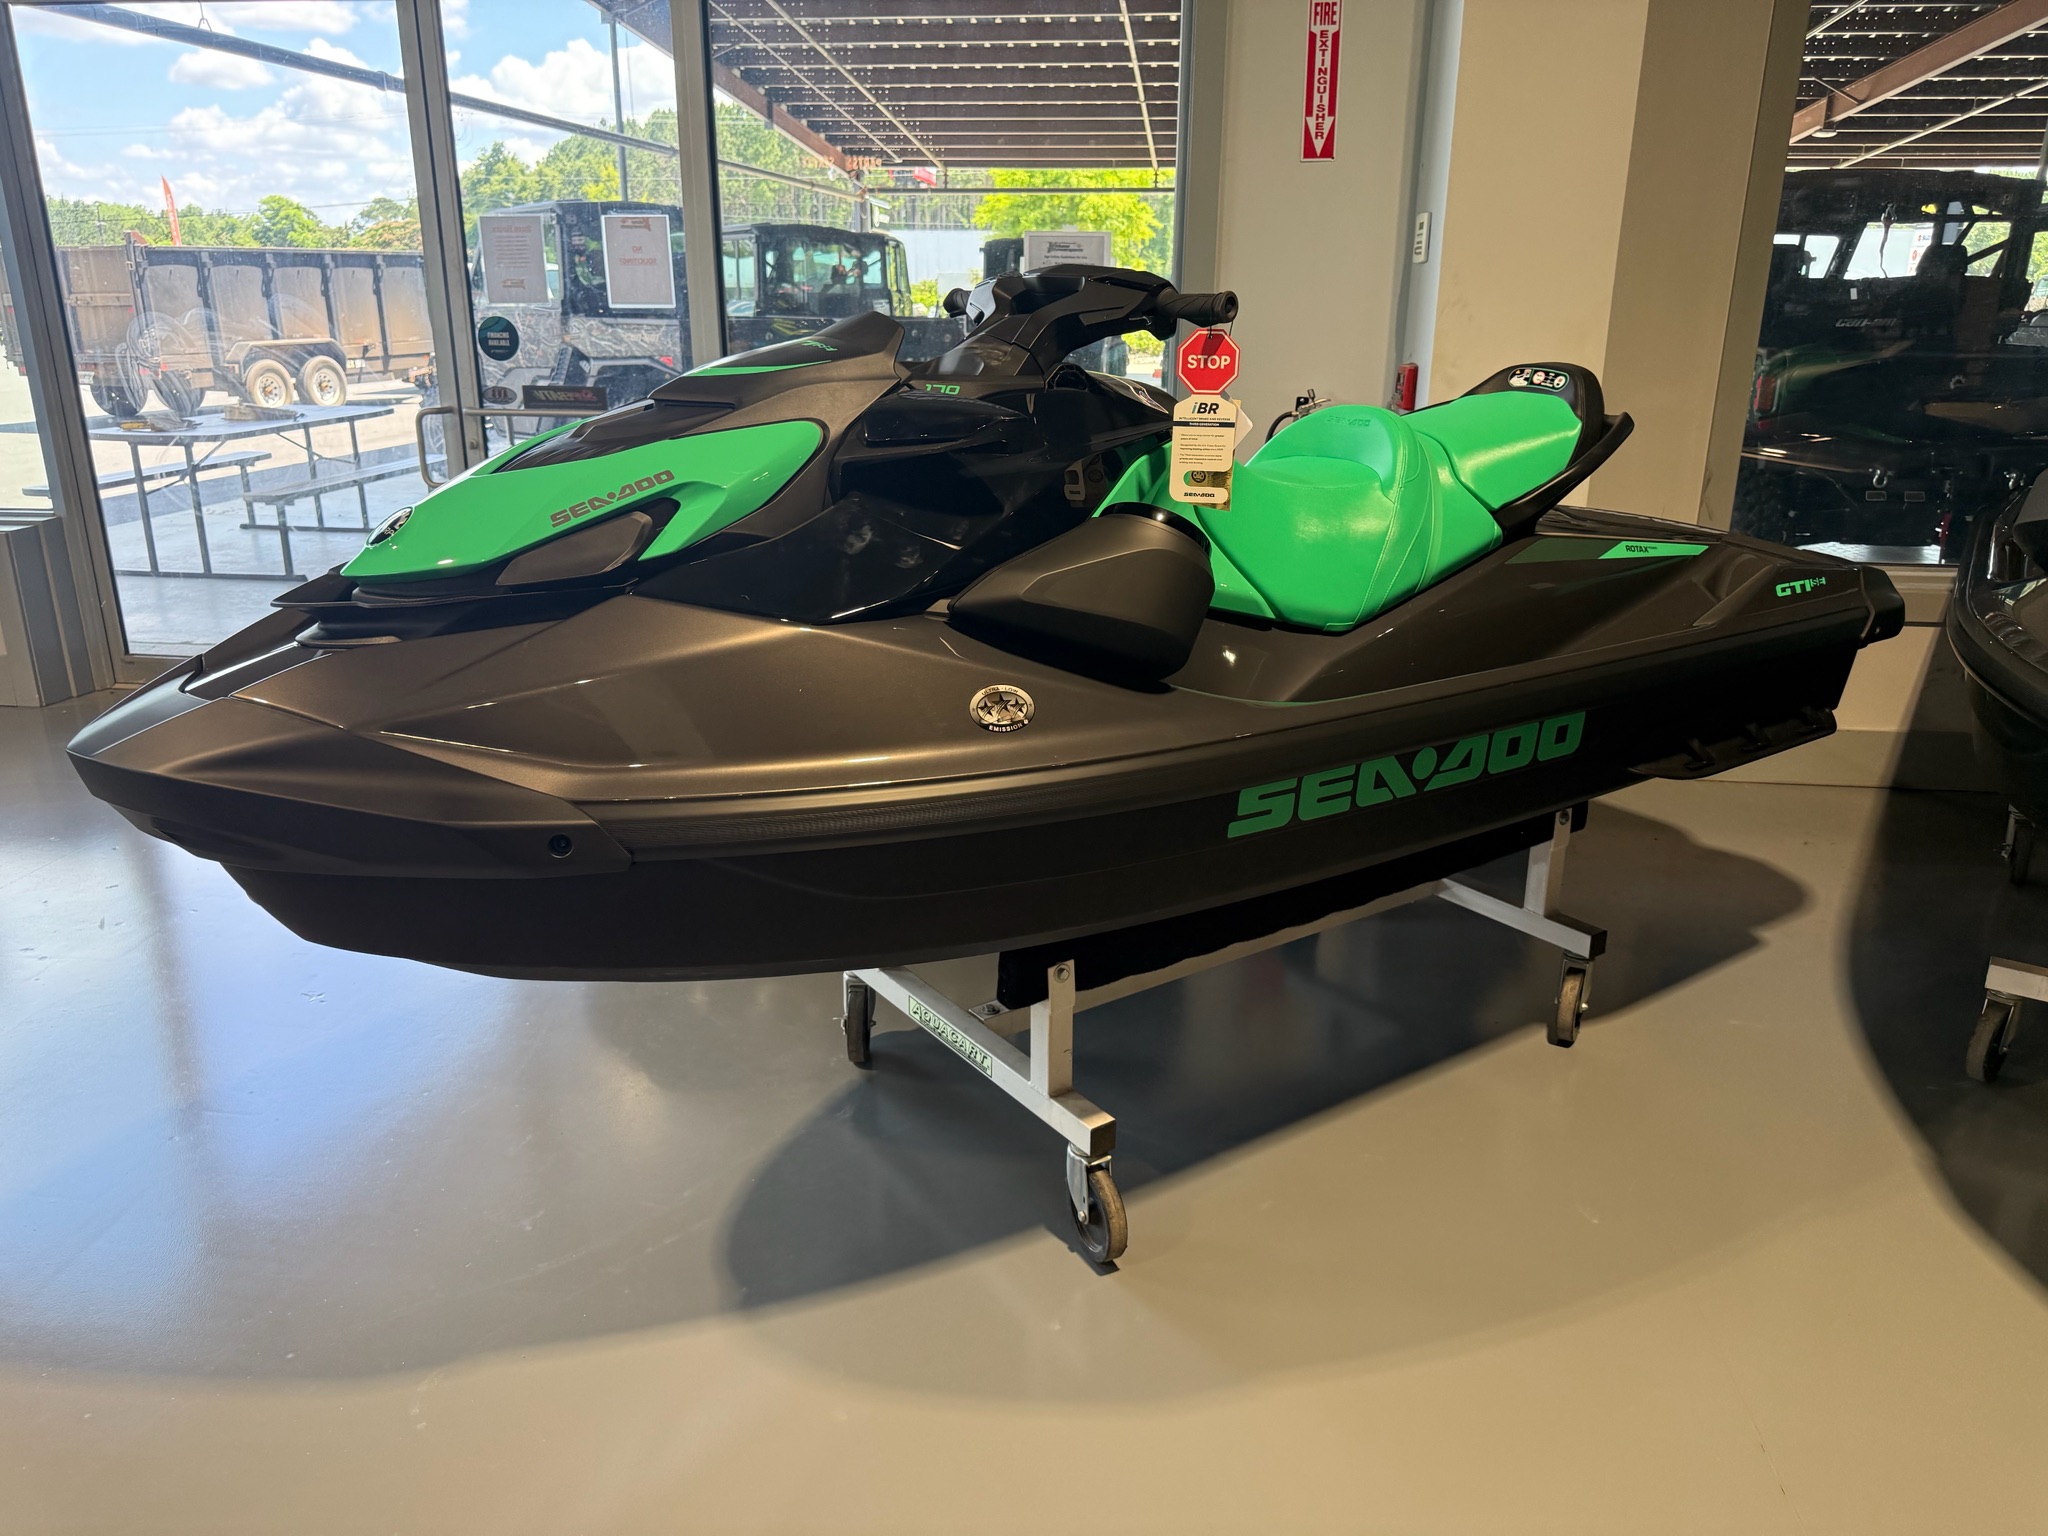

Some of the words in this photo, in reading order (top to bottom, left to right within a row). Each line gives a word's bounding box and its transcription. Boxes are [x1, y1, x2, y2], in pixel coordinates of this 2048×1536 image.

[1313, 1, 1338, 26] FIRE
[1314, 29, 1330, 140] EXTINGUISHER
[1187, 354, 1231, 370] STOP
[925, 383, 961, 395] 170
[1191, 402, 1219, 415] iBR
[1625, 545, 1649, 553] ROTAX
[1775, 579, 1811, 597] GTI
[988, 723, 1023, 732] EMISSION
[911, 1001, 988, 1065] AQUACART
